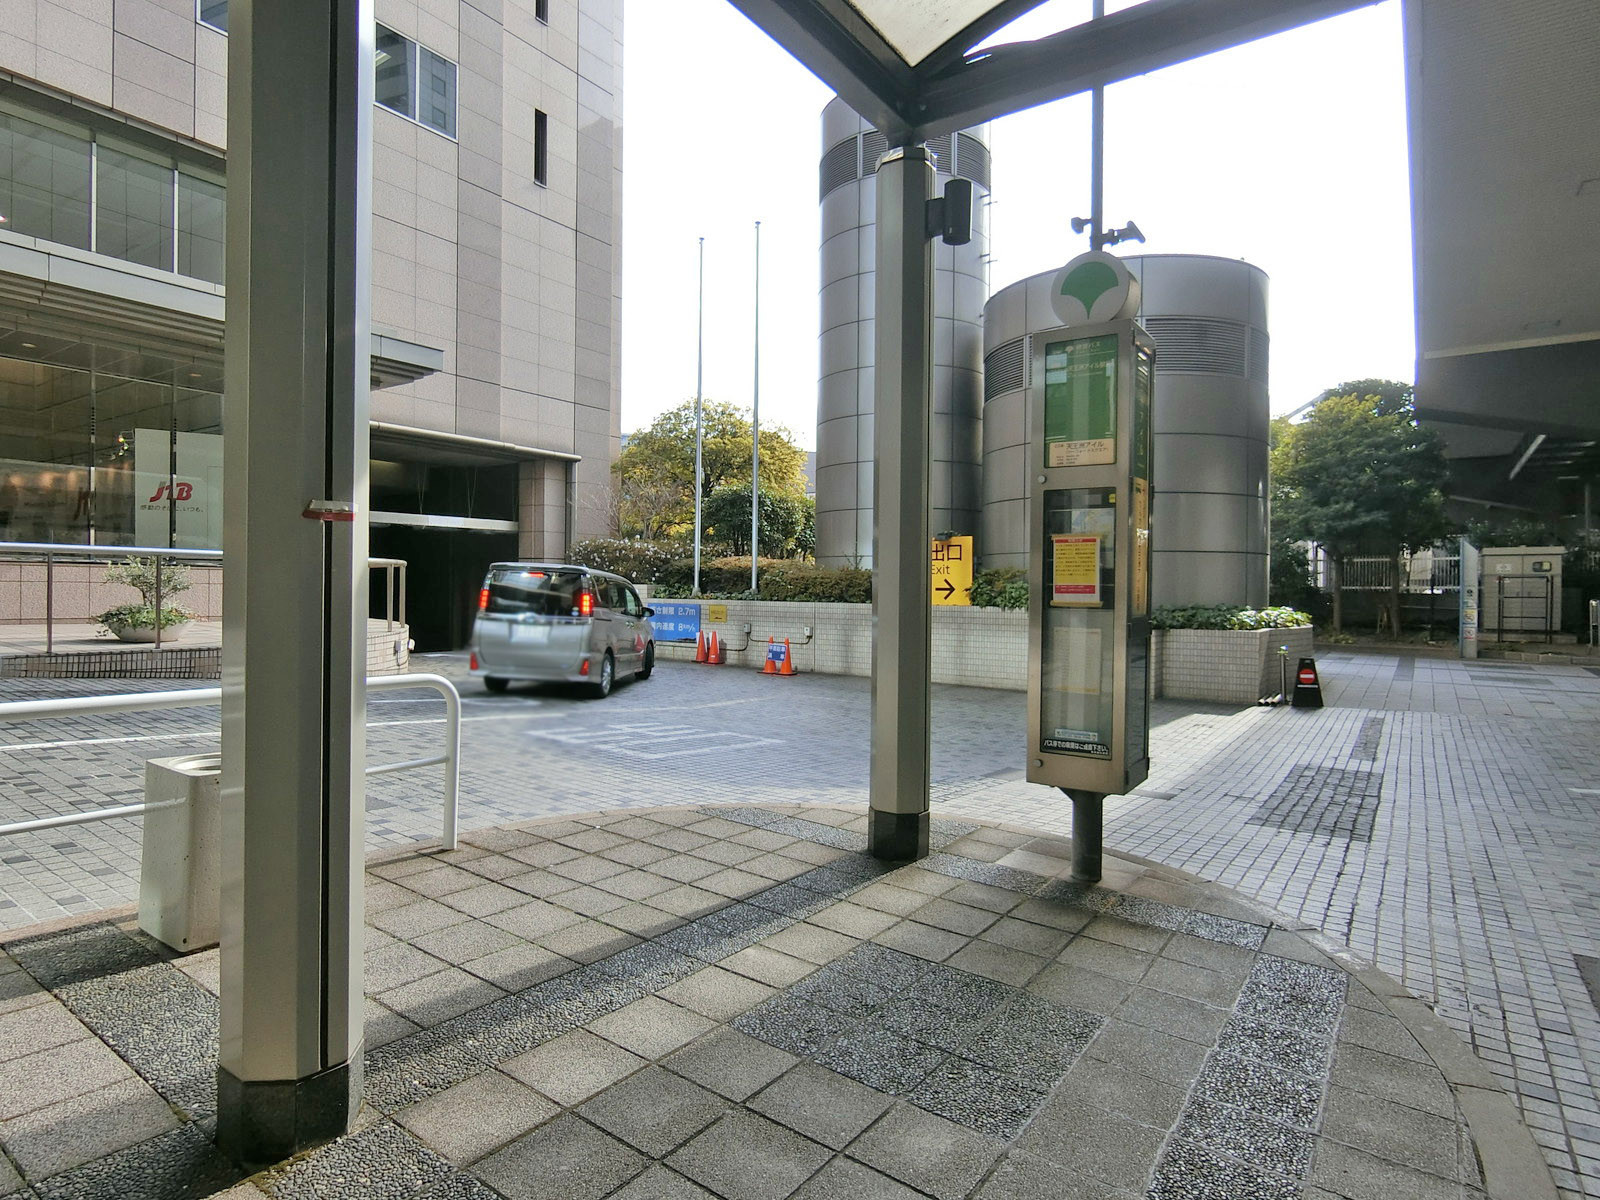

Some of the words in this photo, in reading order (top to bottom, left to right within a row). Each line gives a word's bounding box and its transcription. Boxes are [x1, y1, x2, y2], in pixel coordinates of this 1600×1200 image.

[932, 544, 962, 561] 出口
[932, 565, 950, 575] Exit
[652, 606, 675, 615] さ制限
